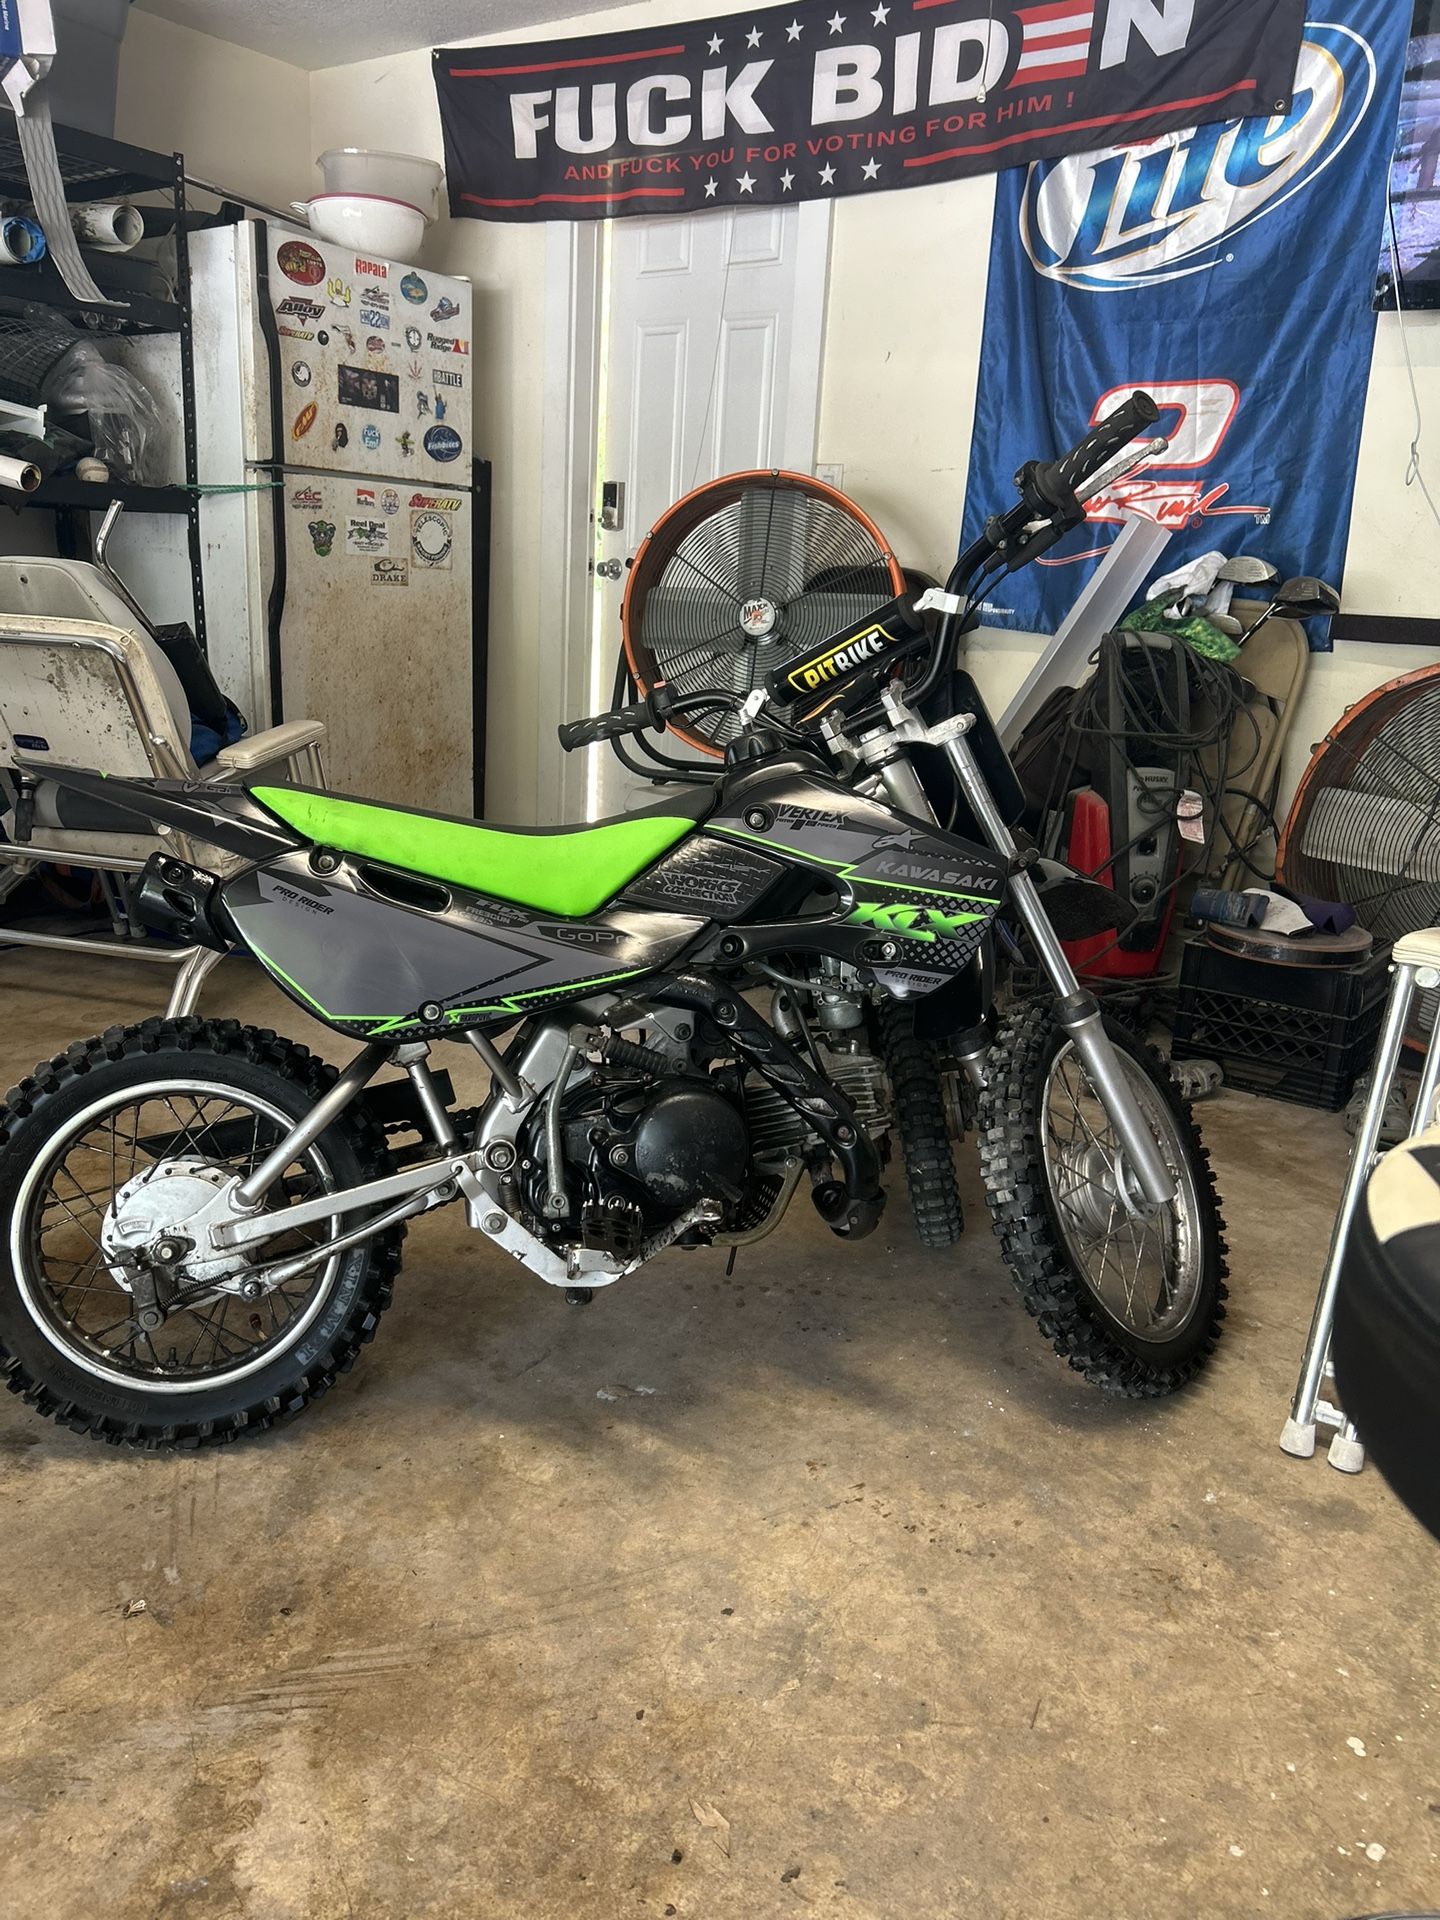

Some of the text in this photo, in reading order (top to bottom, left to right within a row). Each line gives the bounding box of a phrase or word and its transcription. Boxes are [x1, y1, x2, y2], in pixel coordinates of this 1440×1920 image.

[510, 0, 1197, 159] FUCK BIDEN
[564, 164, 612, 181] AND
[619, 158, 683, 177] FUCK
[689, 147, 735, 170] YOU
[746, 142, 797, 163] FOR
[807, 126, 916, 155] VOTING
[926, 112, 987, 137] FOR
[997, 95, 1053, 123] HIM
[355, 257, 387, 278] Rapala
[279, 302, 322, 316] Alloy
[427, 332, 455, 345] Rugged
[431, 341, 452, 352] Ridge
[363, 425, 380, 437] Fuck
[1080, 378, 1241, 530] 2
[350, 519, 368, 528] Reel
[415, 514, 449, 536] TELESCOPIC
[372, 573, 407, 582] DRAKE
[1144, 775, 1168, 783] HUSKY
[778, 803, 850, 825] VERTEX
[876, 860, 998, 891] KAWASAKI
[272, 885, 335, 915] PRO RIDER
[884, 969, 942, 985] PRO RIDER
